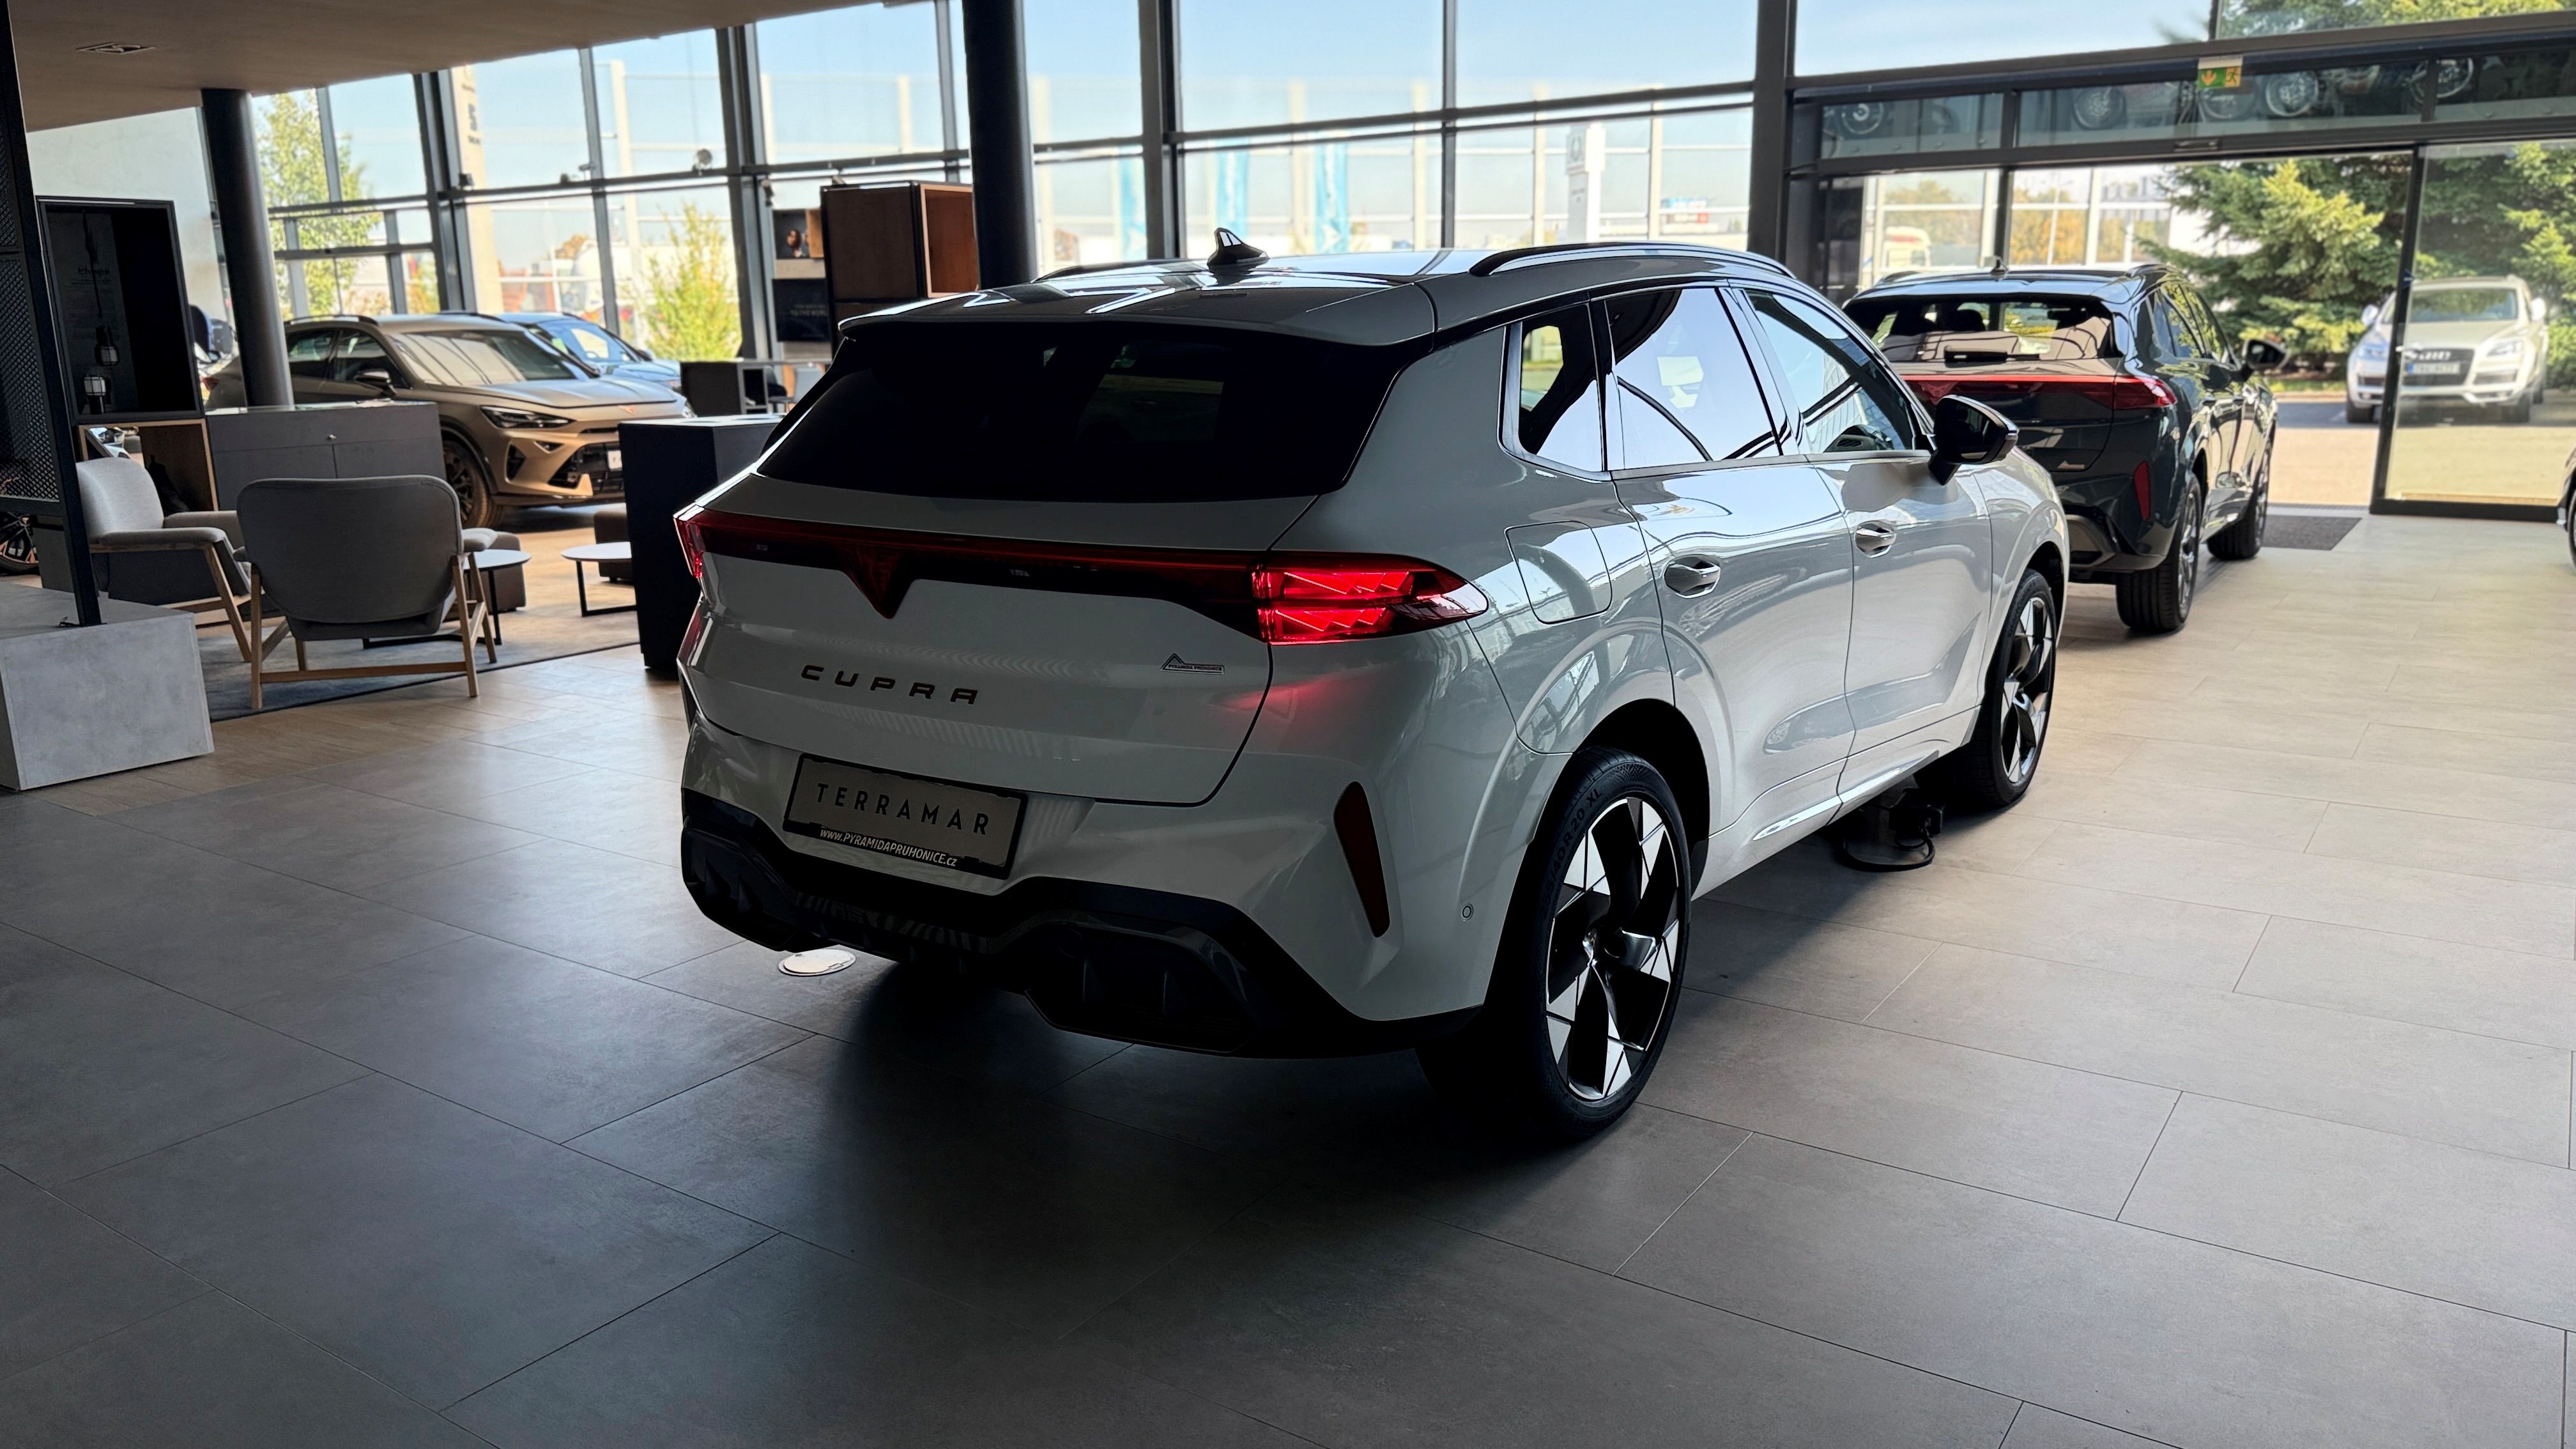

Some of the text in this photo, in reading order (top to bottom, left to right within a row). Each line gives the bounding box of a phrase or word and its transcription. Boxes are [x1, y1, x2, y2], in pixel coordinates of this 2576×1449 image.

[801, 664, 978, 705] CUPRA
[817, 783, 989, 835] TERRAMAR
[1586, 788, 1602, 807] XL
[820, 829, 958, 867] www.PYRAMIDAPRUHONICE.cz
